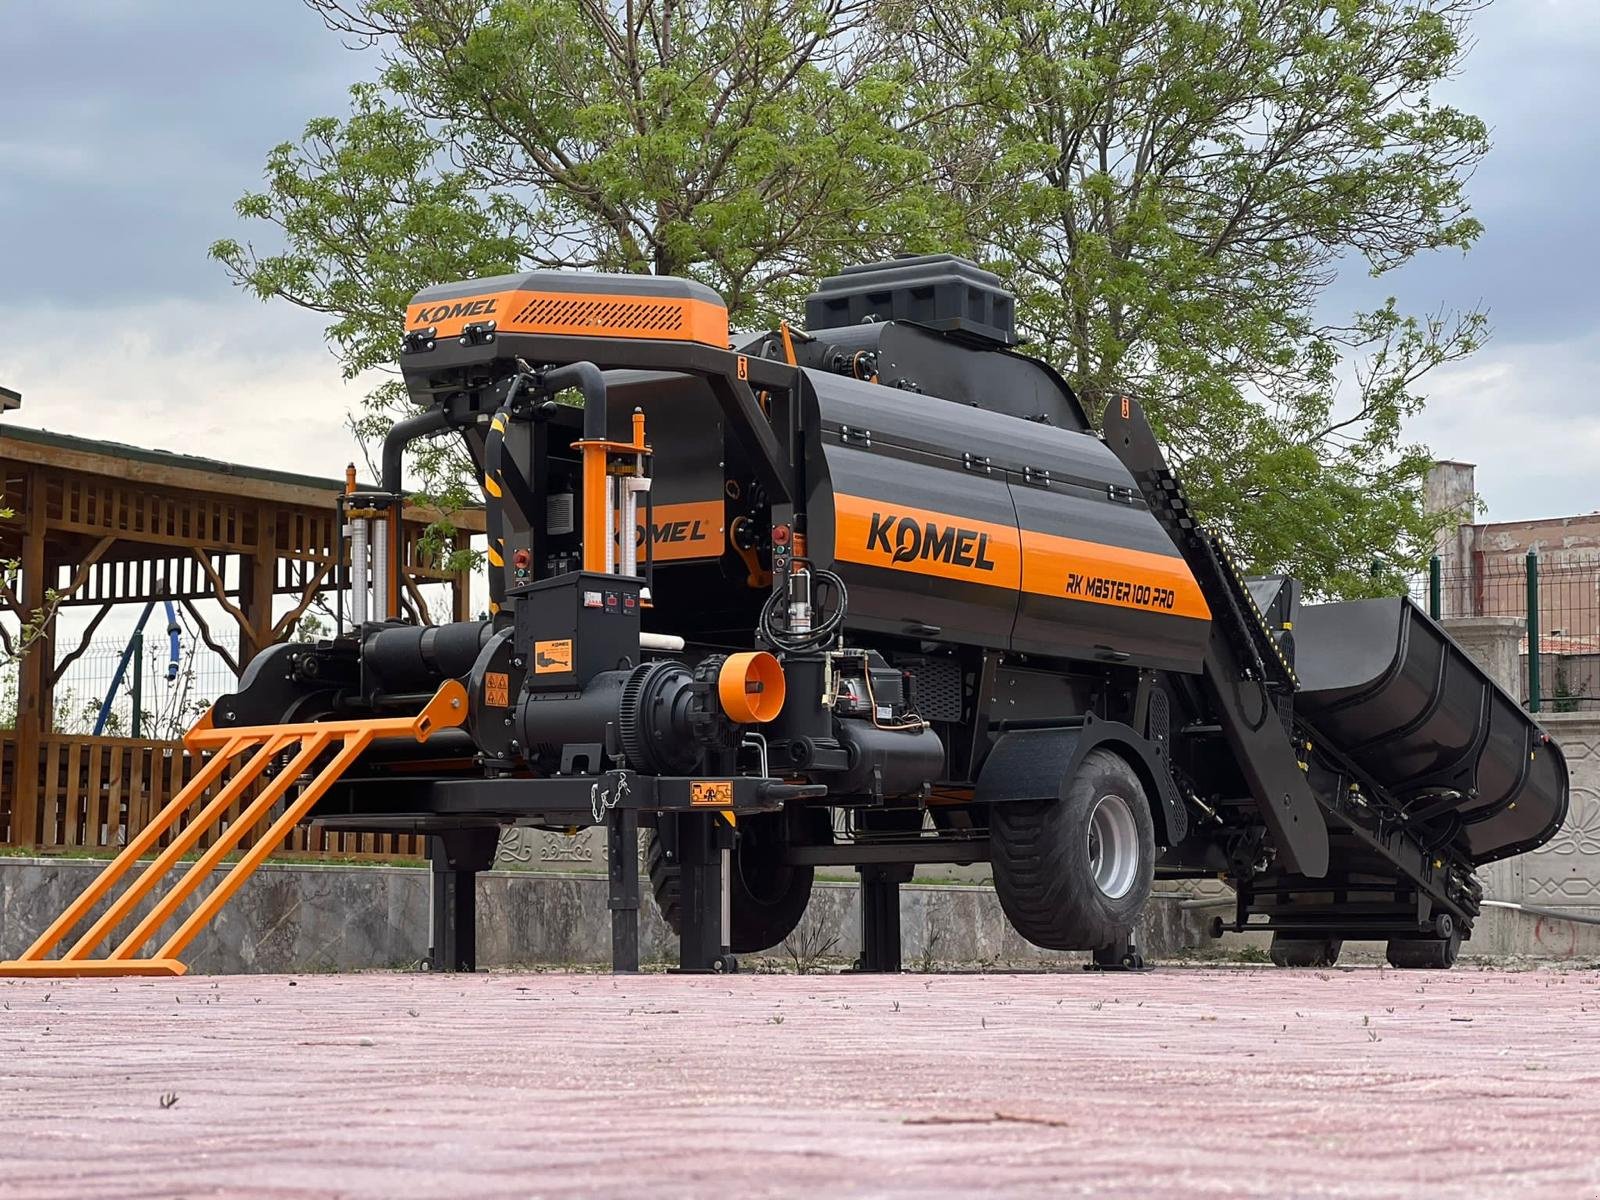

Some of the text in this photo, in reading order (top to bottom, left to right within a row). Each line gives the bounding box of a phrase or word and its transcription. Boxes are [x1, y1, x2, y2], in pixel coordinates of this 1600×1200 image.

[413, 298, 497, 325] KOMEL
[866, 512, 995, 571] KOMEL
[1065, 573, 1084, 594] RK
[1131, 584, 1151, 605] 100
[1151, 587, 1175, 609] PRO
